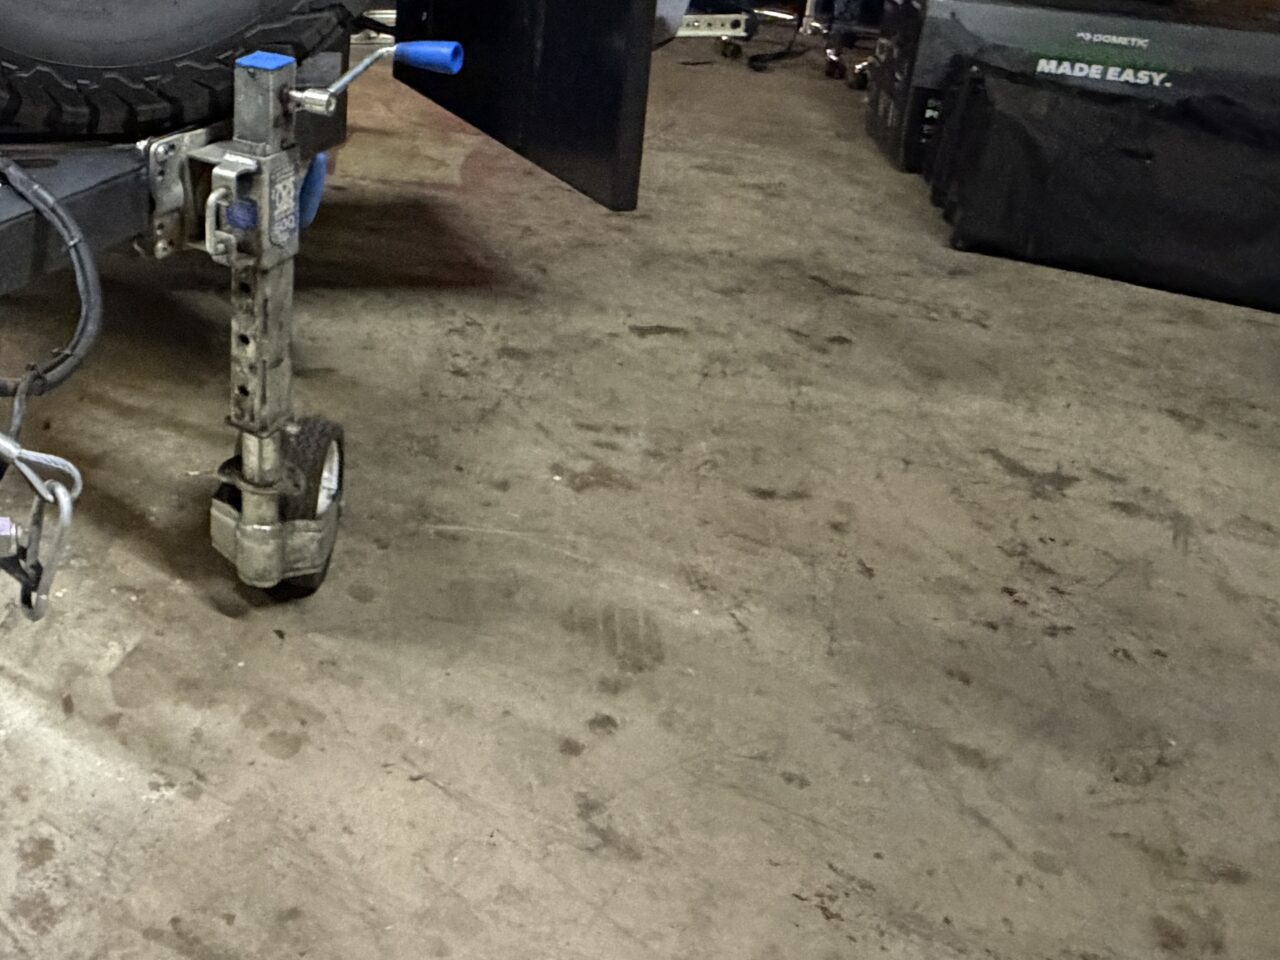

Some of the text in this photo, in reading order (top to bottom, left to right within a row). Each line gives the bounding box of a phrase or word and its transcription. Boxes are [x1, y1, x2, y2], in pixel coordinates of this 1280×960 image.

[1093, 33, 1150, 49] DOMETIC
[1036, 58, 1173, 88] MADE EASY.
